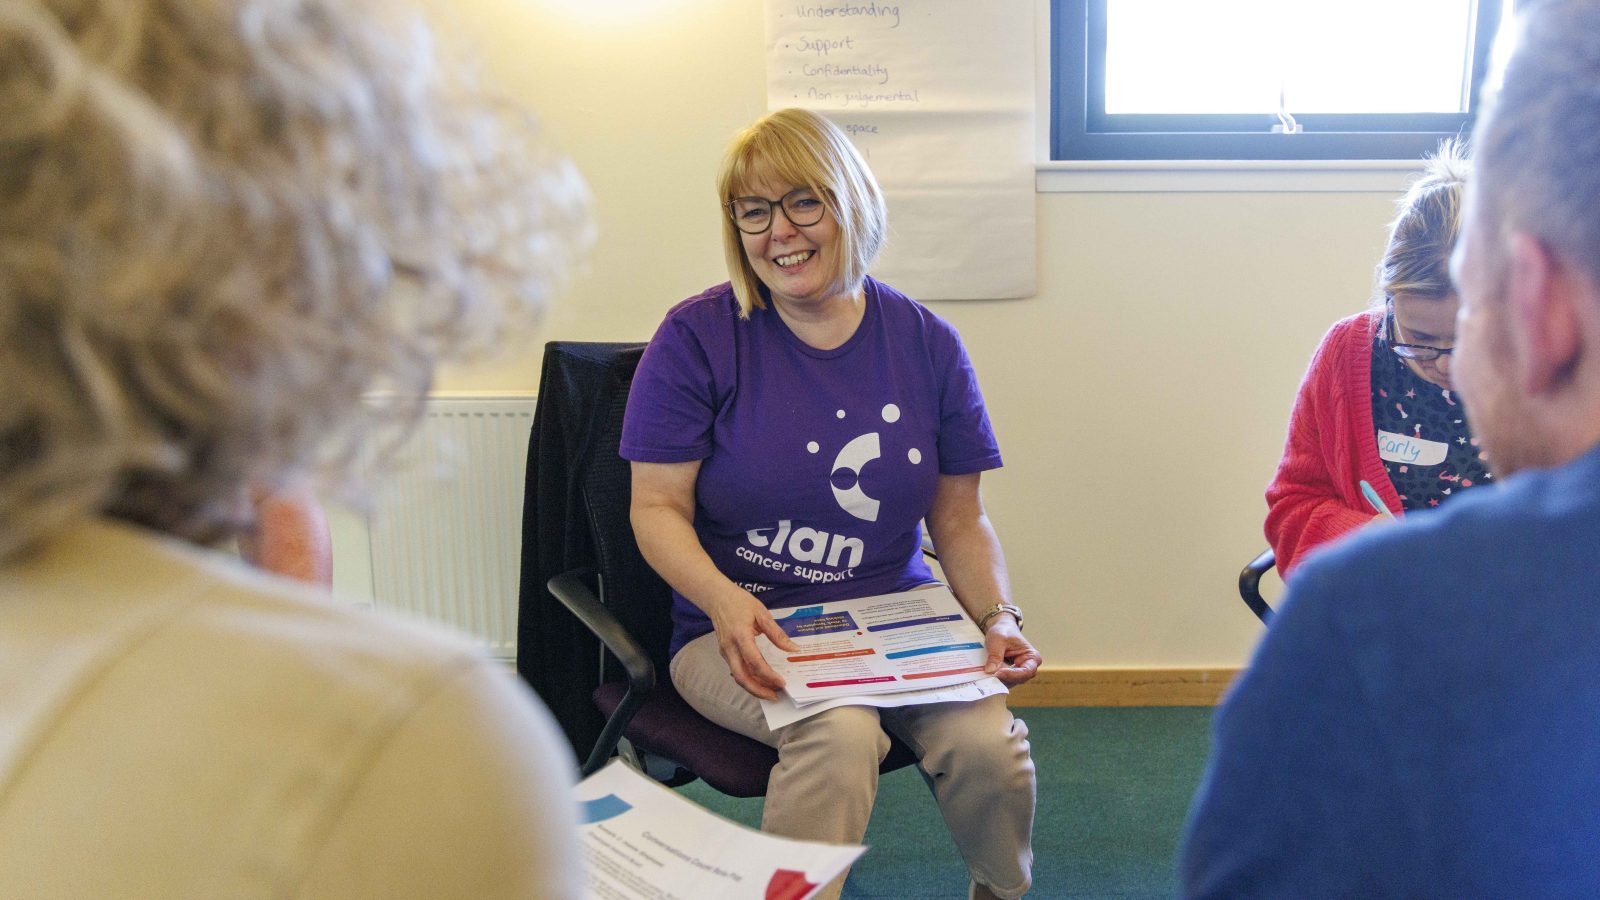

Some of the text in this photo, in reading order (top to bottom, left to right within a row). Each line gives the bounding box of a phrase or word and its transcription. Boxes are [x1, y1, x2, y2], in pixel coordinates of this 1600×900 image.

[797, 3, 900, 28] Understanding
[796, 36, 855, 56] Support
[802, 64, 889, 85] Confidentiality
[846, 124, 878, 136] space
[1379, 436, 1421, 462] Carly
[735, 546, 854, 584] cancer support
